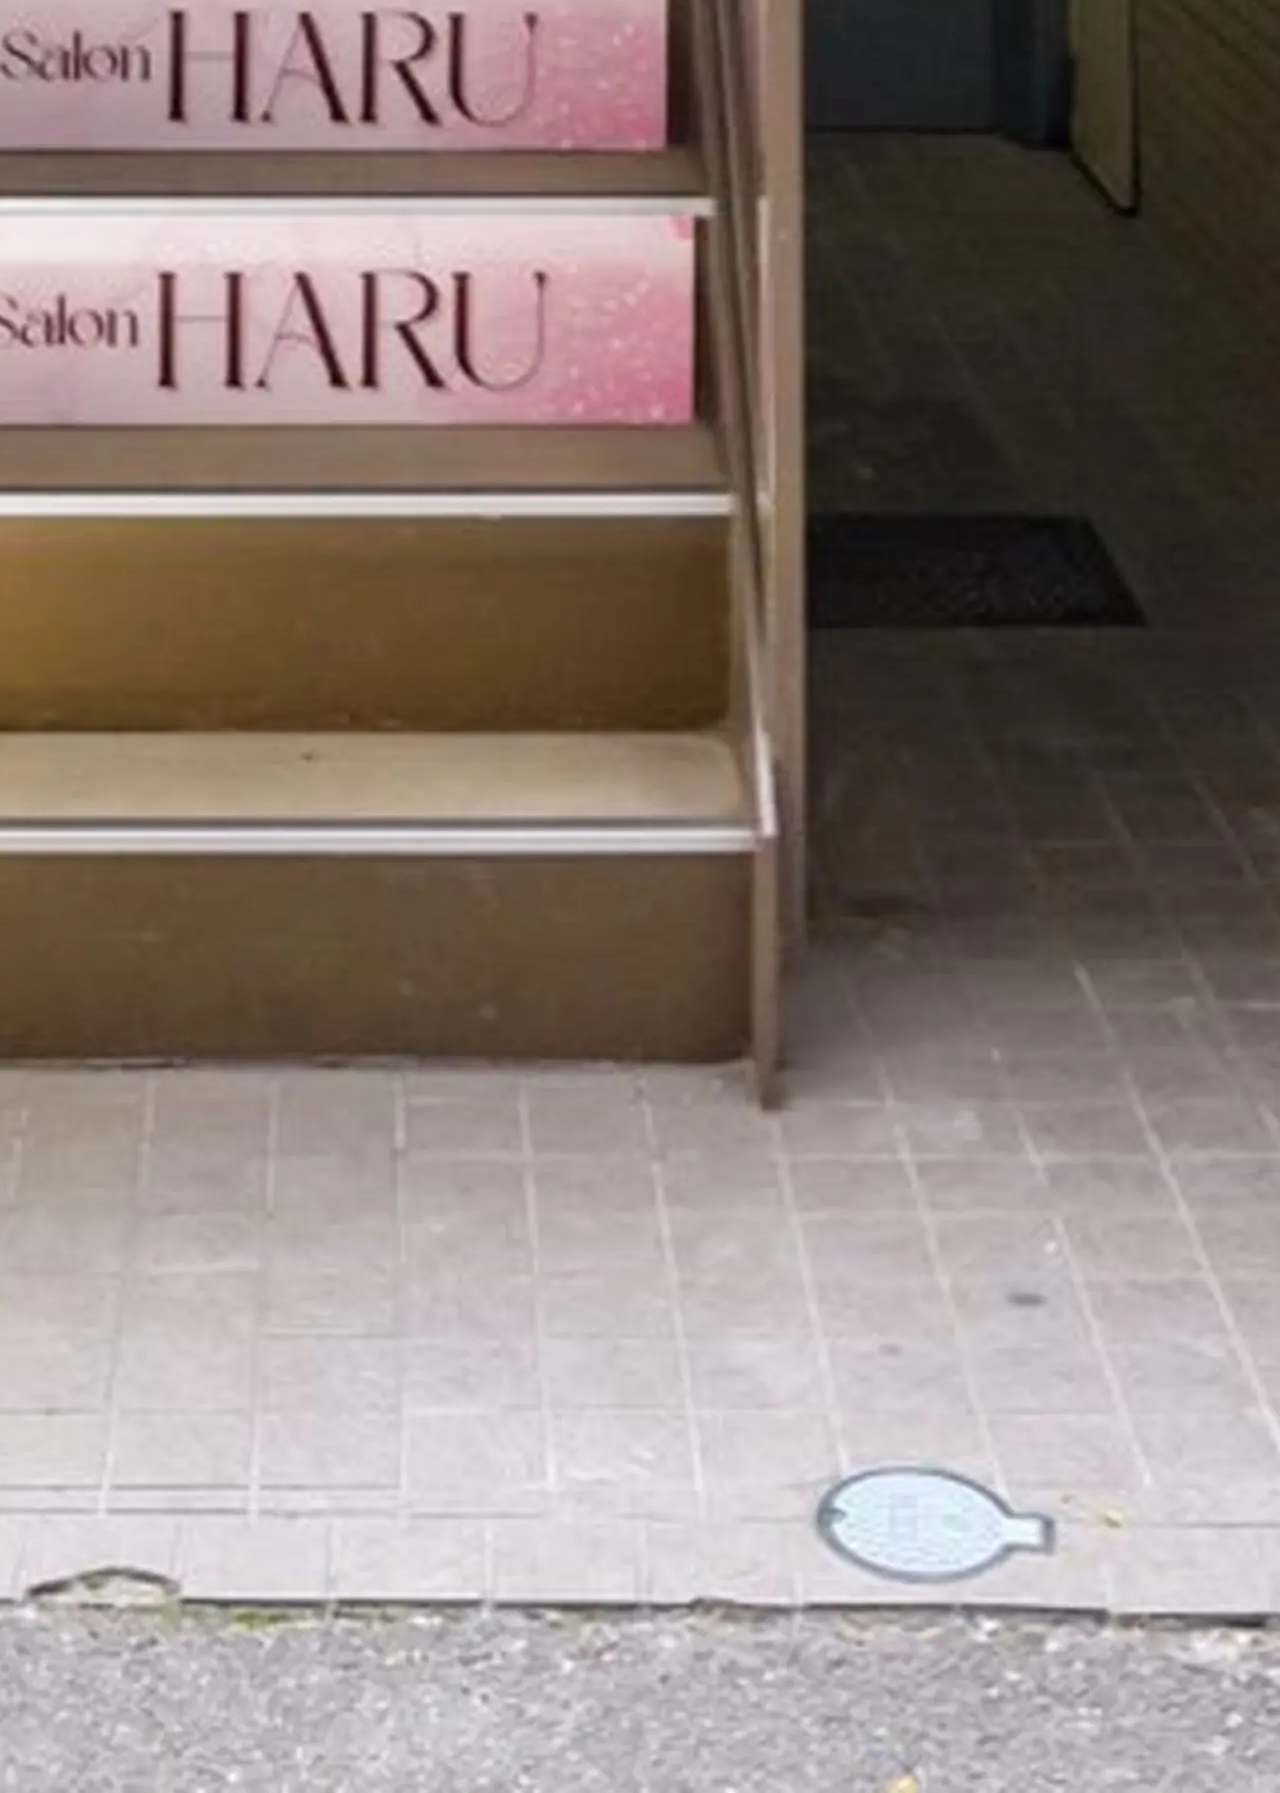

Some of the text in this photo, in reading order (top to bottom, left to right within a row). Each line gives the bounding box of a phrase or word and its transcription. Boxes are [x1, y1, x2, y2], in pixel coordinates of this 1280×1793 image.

[0, 31, 150, 81] Salon
[168, 11, 537, 126] HARU
[158, 272, 546, 390] HARU
